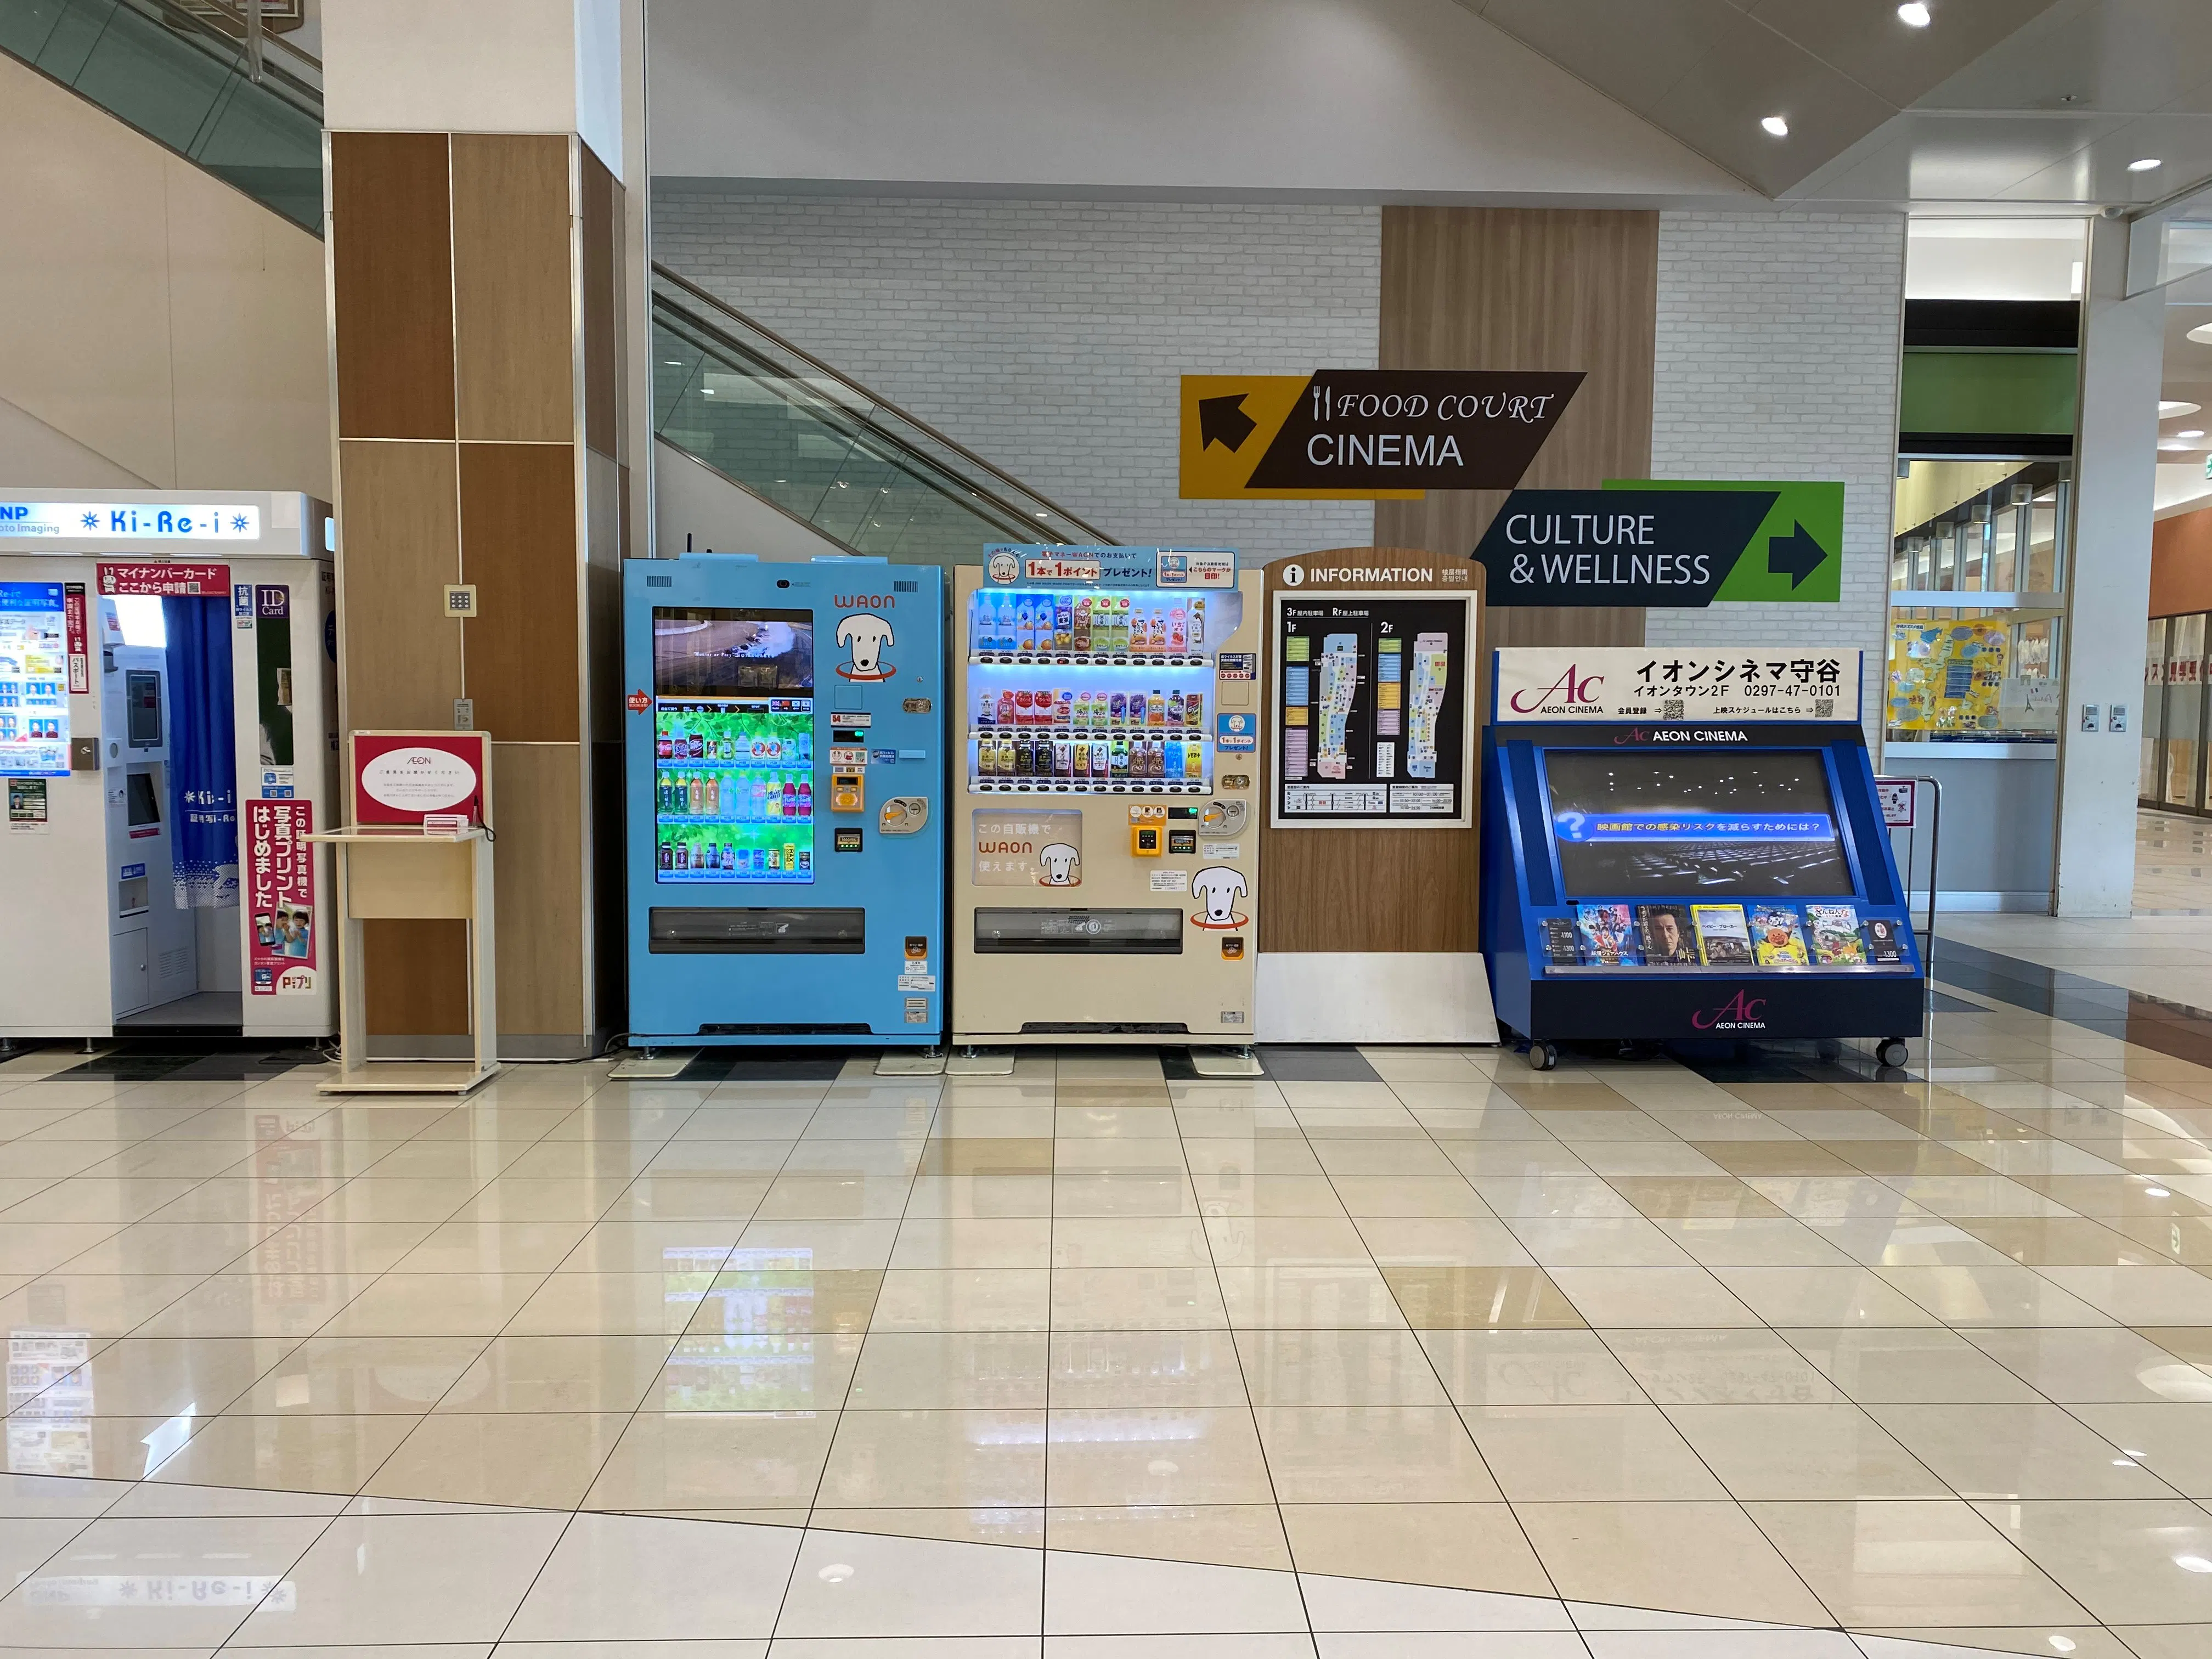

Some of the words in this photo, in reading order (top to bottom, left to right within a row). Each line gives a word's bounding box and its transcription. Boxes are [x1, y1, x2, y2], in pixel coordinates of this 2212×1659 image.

[1337, 392, 1429, 420] FOOD
[1437, 392, 1555, 424] COURT
[1306, 432, 1464, 468] CINEMA
[110, 510, 219, 533] Ki-Re-i
[18, 523, 60, 534] Imaging
[1505, 513, 1656, 547] CULTURE
[117, 567, 217, 580] マイナンバーカード
[1103, 568, 1152, 578] プレゼント!
[1310, 567, 1434, 583] INFORMATION
[1510, 553, 1536, 585] &
[1541, 552, 1712, 586] WELLNESS
[119, 581, 187, 594] ここから申請
[238, 585, 249, 606] 抗菌
[261, 589, 285, 607] ID
[833, 595, 896, 609] WAON
[261, 606, 284, 616] Card
[1286, 607, 1296, 617] 3F
[1332, 607, 1342, 617] RF
[1286, 621, 1297, 633] 1F
[1380, 621, 1394, 634] 2F
[72, 657, 80, 685] パスポート
[1636, 658, 1841, 684] イオンシネマ守谷
[1633, 685, 1730, 697] イオンタウン2F
[1743, 684, 1841, 697] 0297-47-0101
[1539, 706, 1566, 714] AEON
[1567, 706, 1604, 714] CINEMA
[1617, 707, 1647, 715] 会員登録
[1712, 706, 1801, 714] 上映スケジュールはこちら
[1652, 730, 1690, 742] AEON
[1693, 730, 1748, 742] CINEMA
[978, 823, 1051, 835] この自販機で
[978, 841, 1032, 854] WAON
[253, 805, 273, 909] はじめました
[273, 805, 294, 909] 写真プリント
